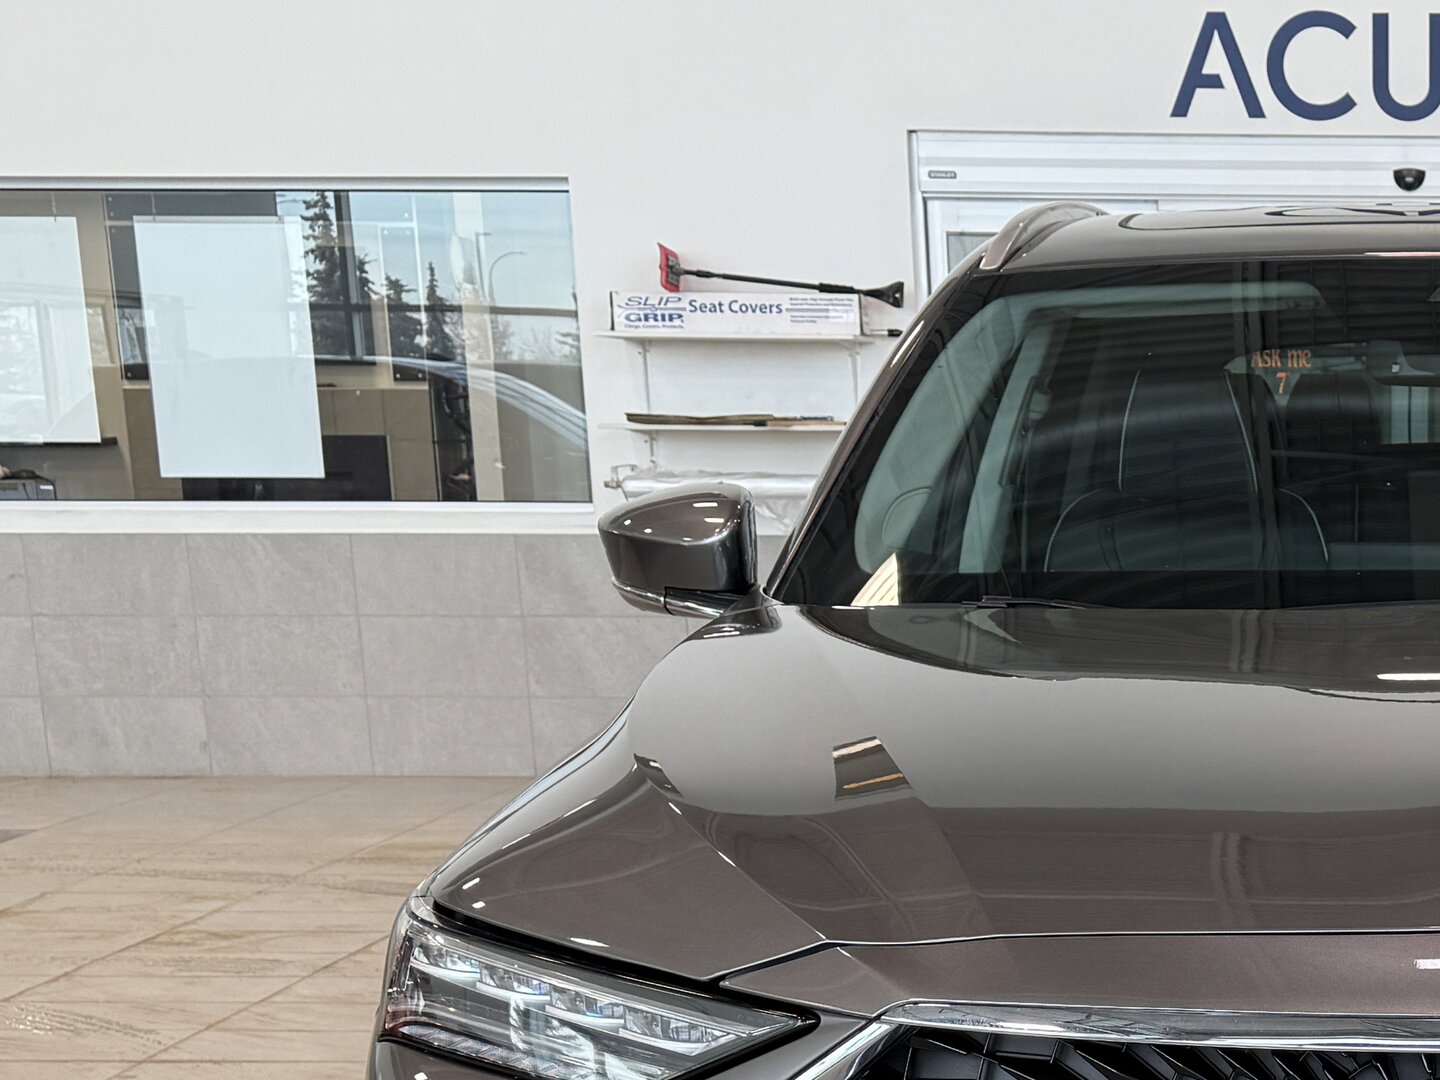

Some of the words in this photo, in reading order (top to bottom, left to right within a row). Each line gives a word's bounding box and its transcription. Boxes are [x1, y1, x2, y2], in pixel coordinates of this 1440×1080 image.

[625, 296, 682, 306] SLIP
[689, 299, 724, 313] Seat
[728, 300, 783, 314] Covers
[624, 313, 682, 323] GRIP
